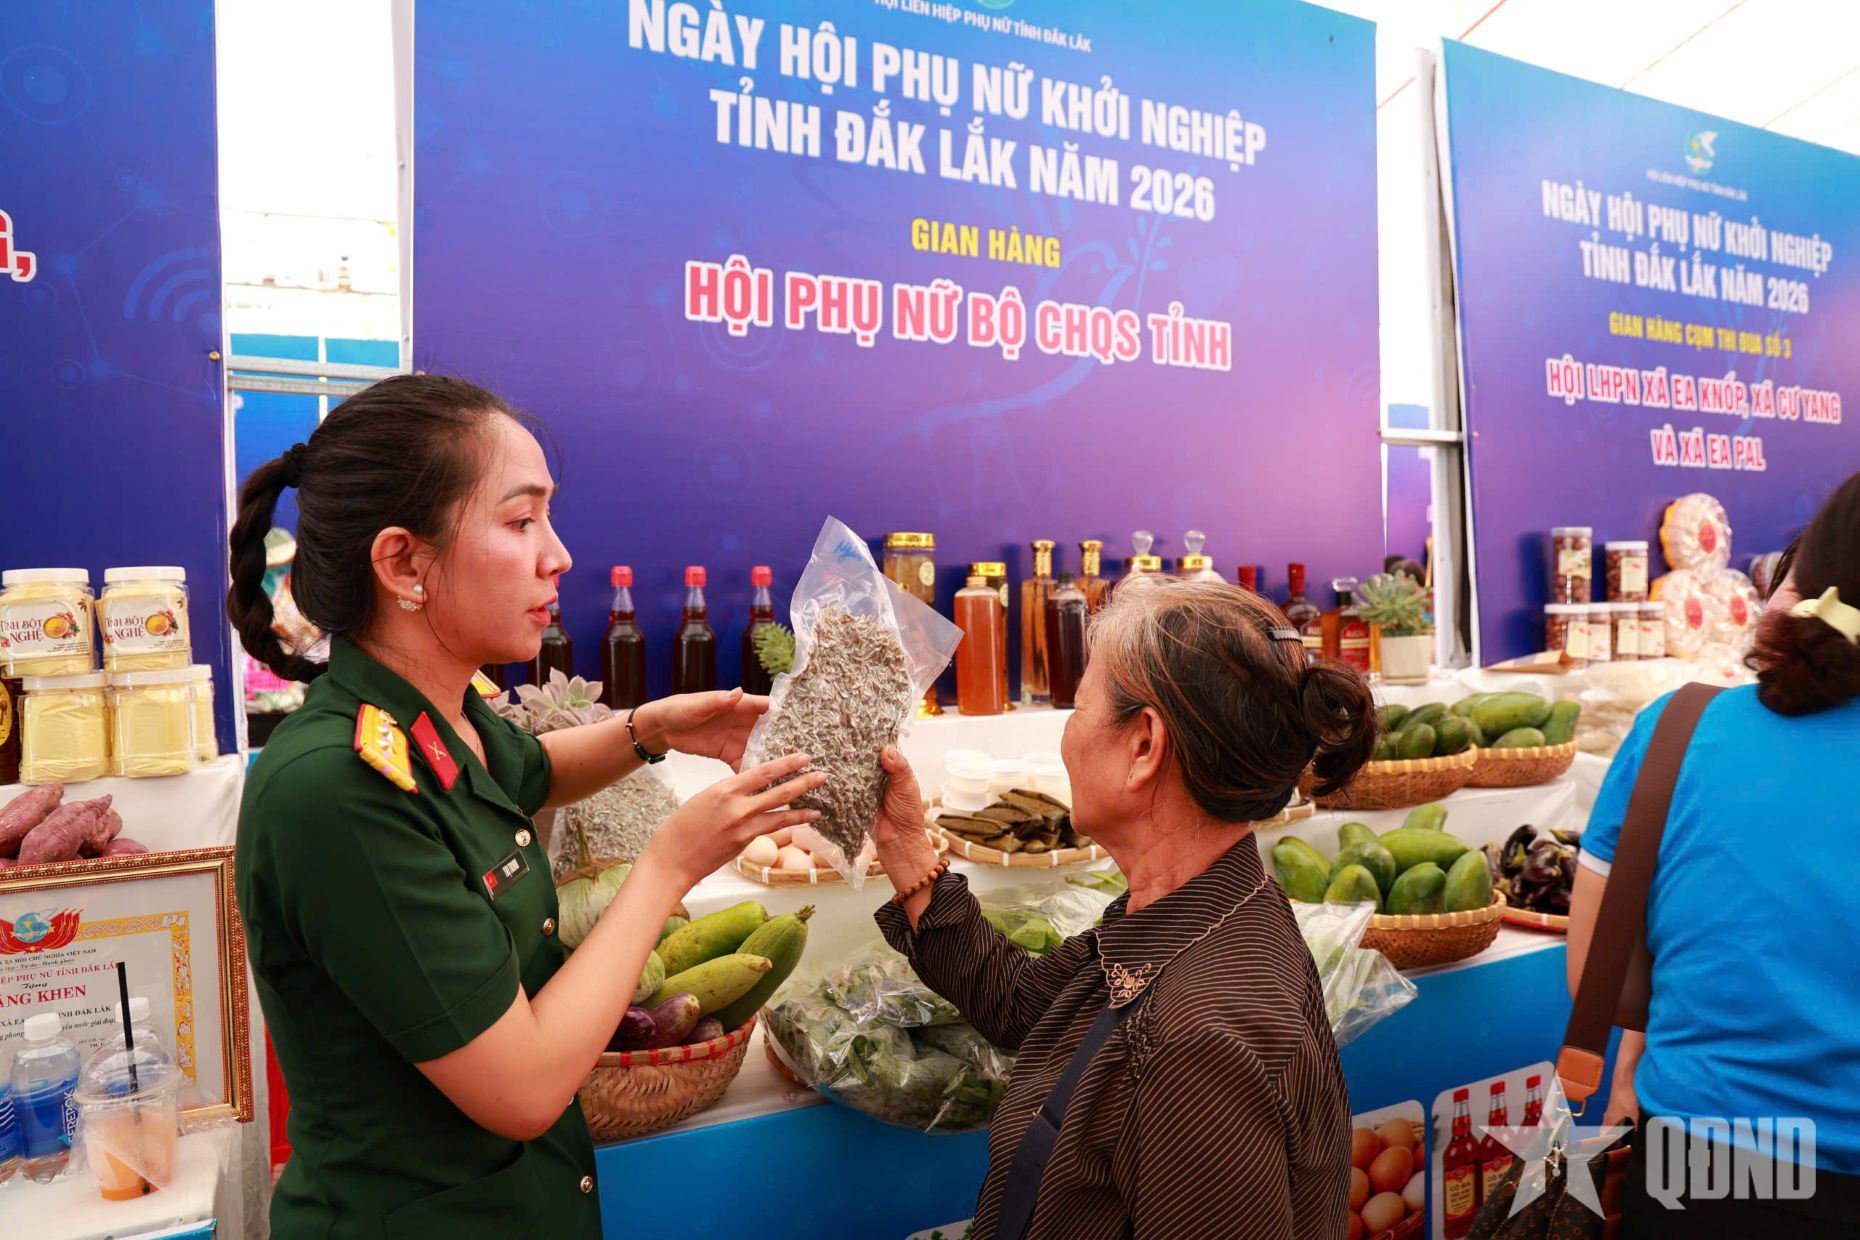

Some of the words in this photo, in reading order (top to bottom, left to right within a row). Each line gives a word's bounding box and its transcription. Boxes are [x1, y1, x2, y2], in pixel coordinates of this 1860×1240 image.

[932, 3, 962, 23] HIỆP
[963, 10, 990, 32] PHỤ
[992, 16, 1012, 34] NỮ
[1013, 17, 1041, 40] TỈNH
[628, 0, 765, 70] NGÀY
[779, 22, 857, 92] HỘI
[871, 42, 960, 117] PHỤ
[971, 61, 1035, 121] NỮ
[1041, 74, 1131, 142] KHỞI
[1141, 99, 1266, 174] NGHIỆP
[709, 76, 821, 158] TỈNH
[834, 98, 926, 174] ĐẮK
[938, 115, 1018, 189] LẮK
[1029, 140, 1119, 206] NĂM
[1130, 165, 1216, 222] 2026
[911, 217, 979, 258] GIAN
[988, 221, 1062, 269] HÀNG
[1541, 180, 1602, 227] NGÀY
[1607, 192, 1643, 242] HỘI
[1648, 203, 1690, 252] PHỤ
[1693, 211, 1723, 251] NỮ
[1724, 216, 1768, 260] KHỞI
[1771, 231, 1832, 278] NGHIỆP
[1580, 231, 1630, 284] TỈNH
[1634, 242, 1677, 292] ĐẮK
[1680, 251, 1717, 299] LẮK
[1721, 264, 1763, 307] NĂM
[1768, 280, 1810, 314] 2026
[685, 253, 773, 336] HỘI
[784, 272, 883, 347] PHỤ
[893, 277, 963, 348] NỮ
[967, 286, 1026, 360] BỘ
[1035, 299, 1141, 364] CHQS
[1146, 300, 1232, 371] TỈNH
[1609, 311, 1643, 338] GIAN
[1646, 315, 1683, 344] HÀNG
[1685, 323, 1714, 351] CỤM
[1717, 327, 1736, 351] THI
[1739, 331, 1763, 355] ĐUA
[1765, 330, 1781, 357] SỐ
[1783, 338, 1791, 359] 3
[1546, 354, 1584, 405] HỘI
[1587, 363, 1640, 405] LHPN
[1642, 367, 1670, 407] XÃ
[1671, 373, 1697, 410] EA
[1698, 370, 1749, 419] KNỐP,
[1750, 380, 1775, 418] XÃ
[1776, 386, 1801, 420] CƯ
[1801, 389, 1841, 424] YANG
[1651, 424, 1677, 465] VÀ
[1679, 428, 1706, 467] XÃ
[1707, 434, 1732, 468] EA
[1733, 436, 1766, 471] PAL
[37, 985, 87, 1003] KHEN
